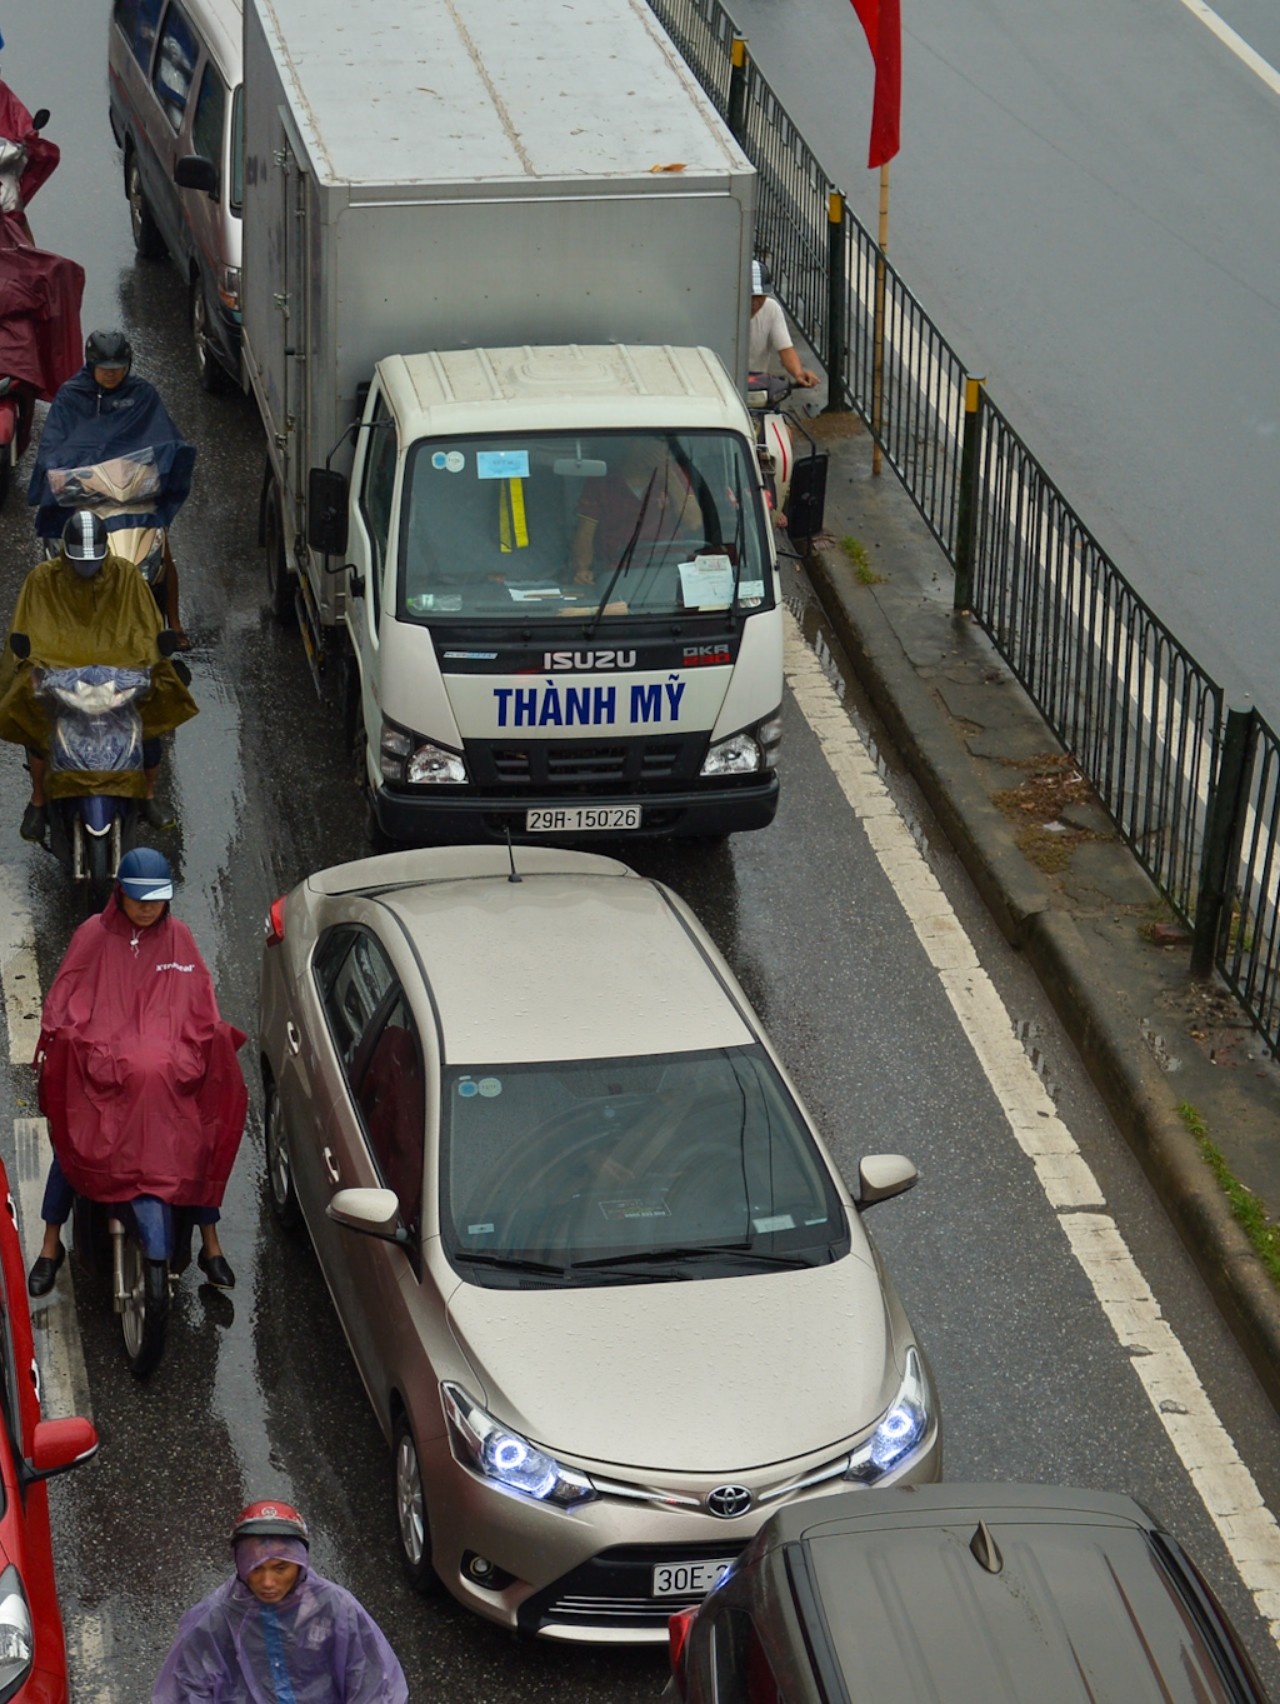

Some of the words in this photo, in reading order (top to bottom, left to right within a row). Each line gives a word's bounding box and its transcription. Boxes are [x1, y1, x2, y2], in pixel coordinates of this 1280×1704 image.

[543, 650, 637, 670] ISUZU
[493, 679, 617, 727] THÀNH
[630, 674, 686, 723] MỸ
